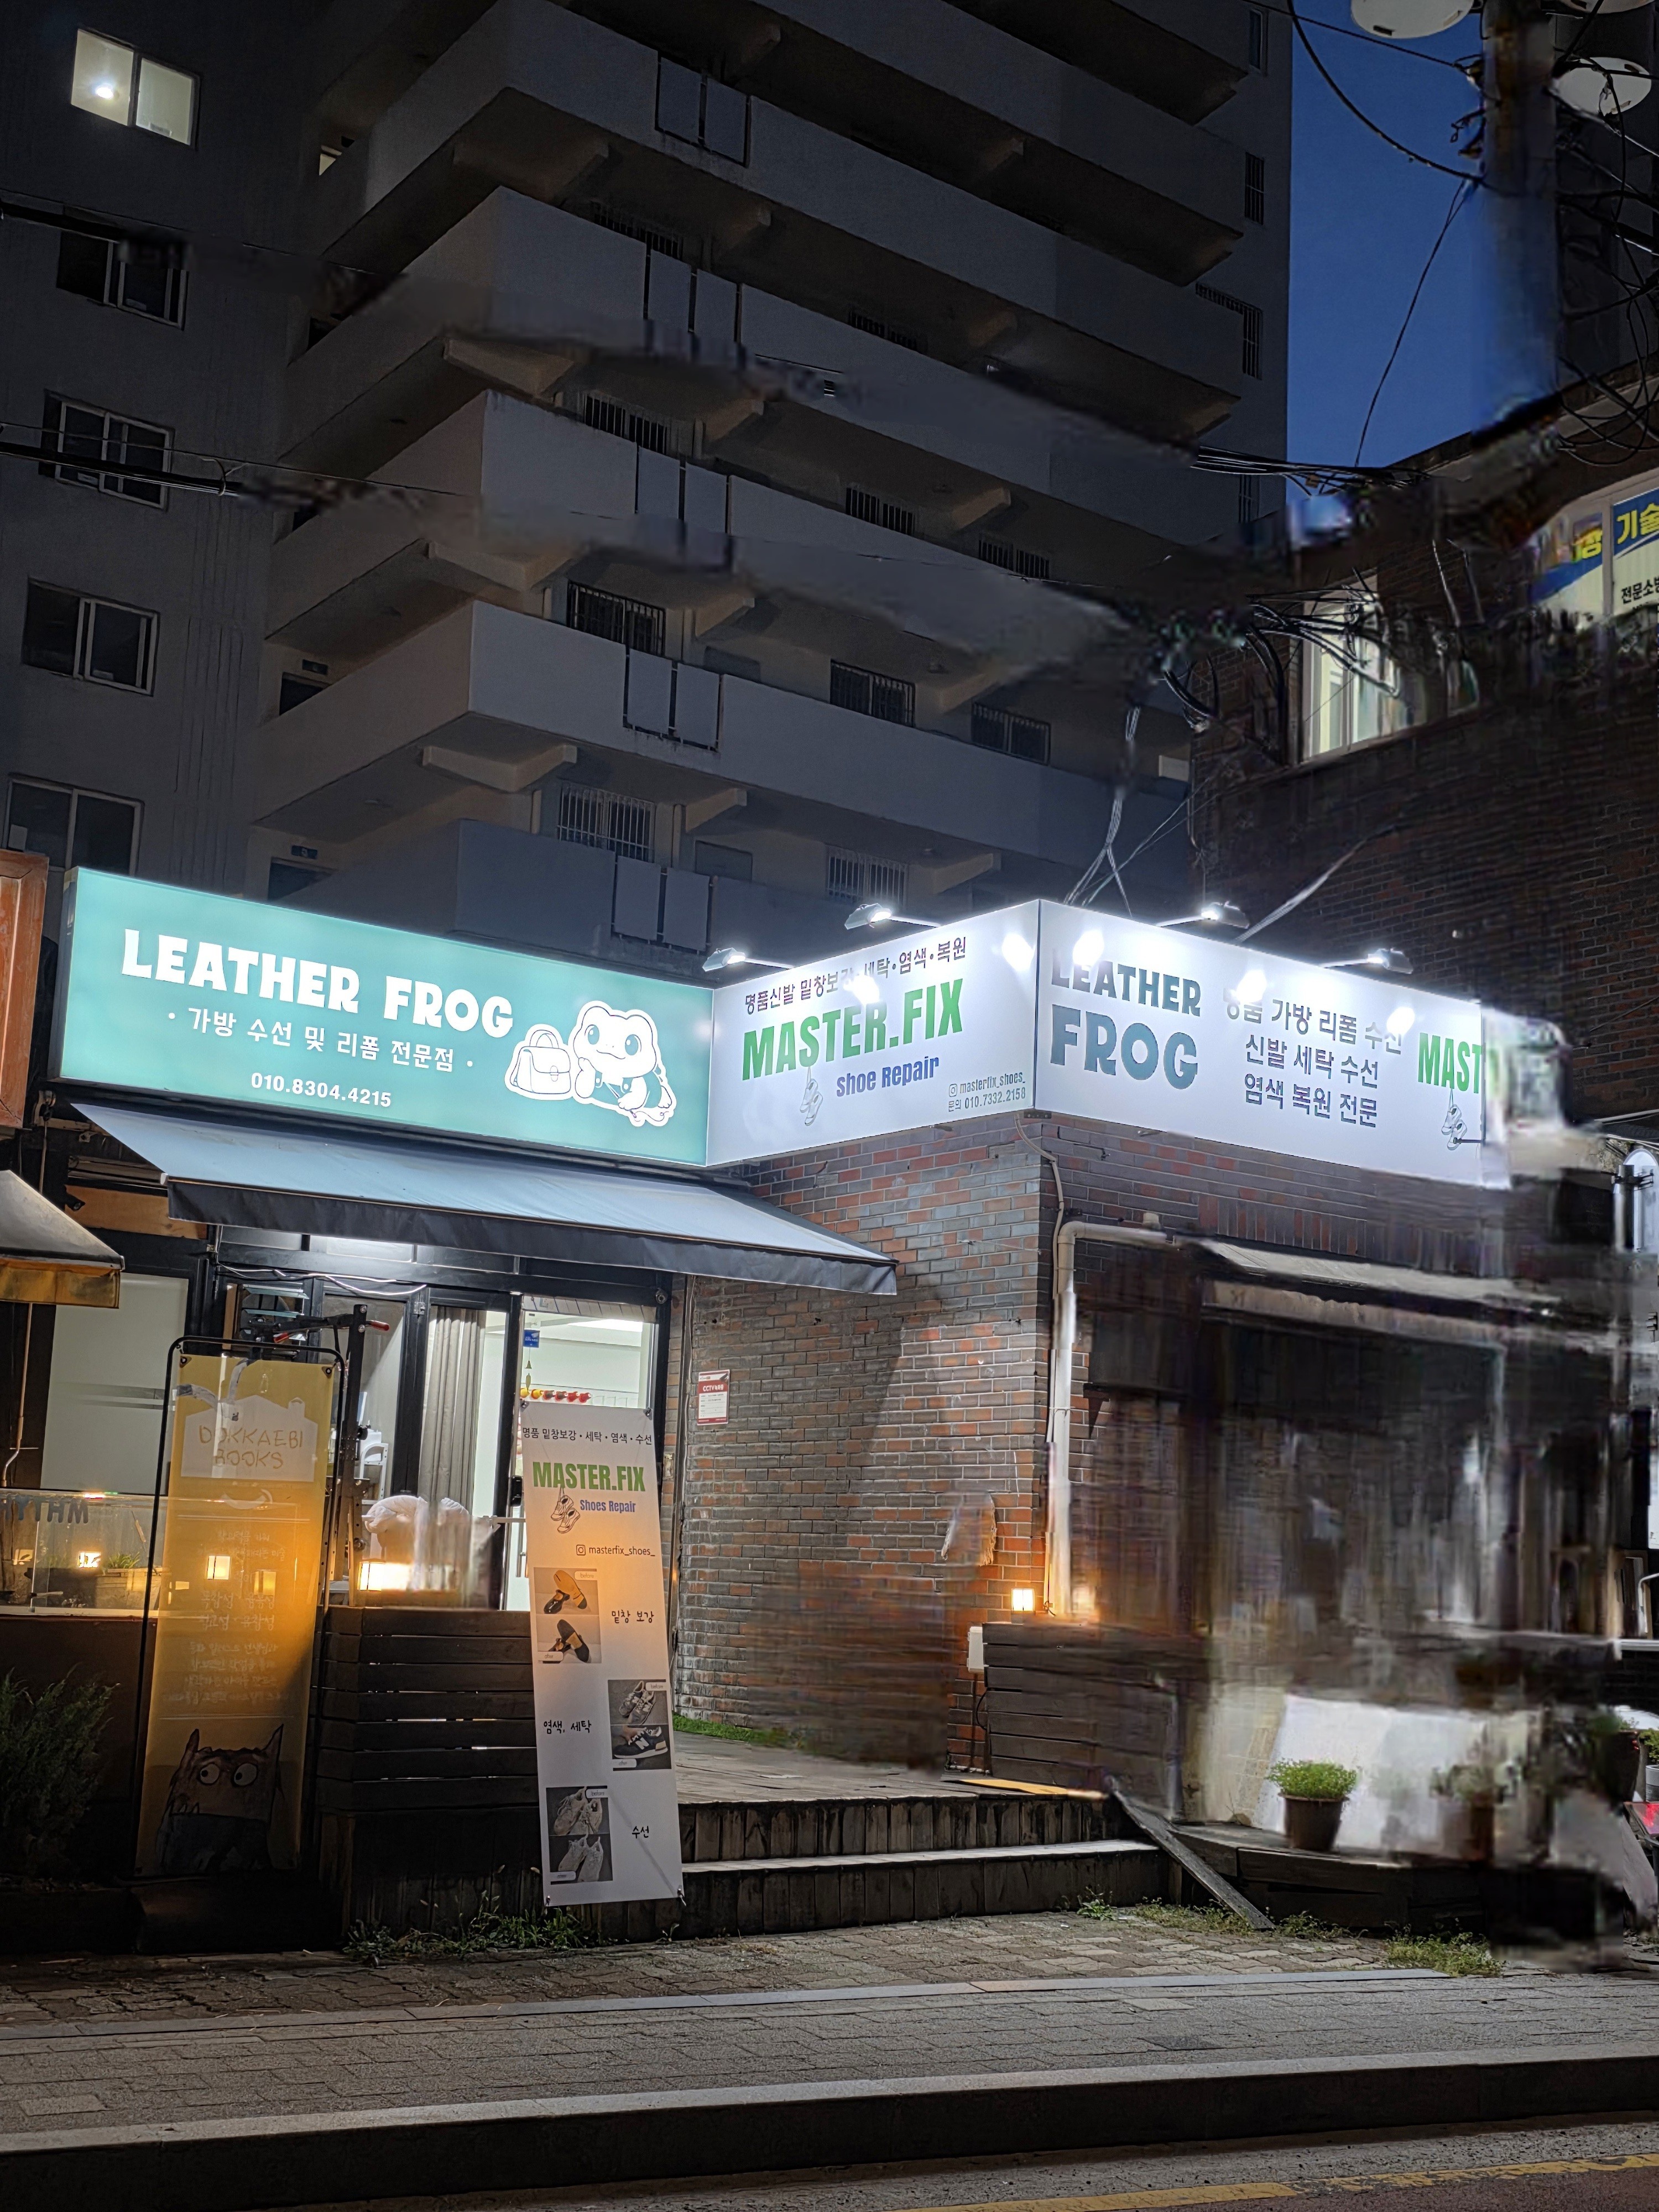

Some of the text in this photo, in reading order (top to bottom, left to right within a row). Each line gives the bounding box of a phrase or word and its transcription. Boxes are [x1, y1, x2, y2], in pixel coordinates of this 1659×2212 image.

[122, 928, 513, 1039] LEATHER FROG
[1051, 948, 1202, 1017] LEATHER
[742, 978, 964, 1081] MASTER.FIX
[1271, 999, 1312, 1035] 가방
[1319, 1010, 1357, 1045] 리폼
[188, 1008, 455, 1073] 가방 수선 및 리폼 전문점
[1050, 1004, 1198, 1089] FROG
[881, 1056, 940, 1088] Repair
[1245, 1034, 1379, 1089] 신발 세탁 수선
[251, 1072, 392, 1108] 010.8304.4215
[948, 1087, 1026, 1112] 문의 010.7332.2158
[1244, 1073, 1378, 1128] 염색 복원 전문
[199, 1425, 303, 1449] DOKKAEBI
[523, 1427, 540, 1439] 명품
[542, 1428, 577, 1441] 밑창보강
[533, 1461, 646, 1491] MASTER.FIX
[580, 1499, 636, 1514] Shoes Repair
[589, 1546, 656, 1557] masterfix_shoes_
[611, 1609, 654, 1624] 밑창 보강
[570, 1720, 592, 1734] 세탁
[631, 1825, 650, 1839] 수선
